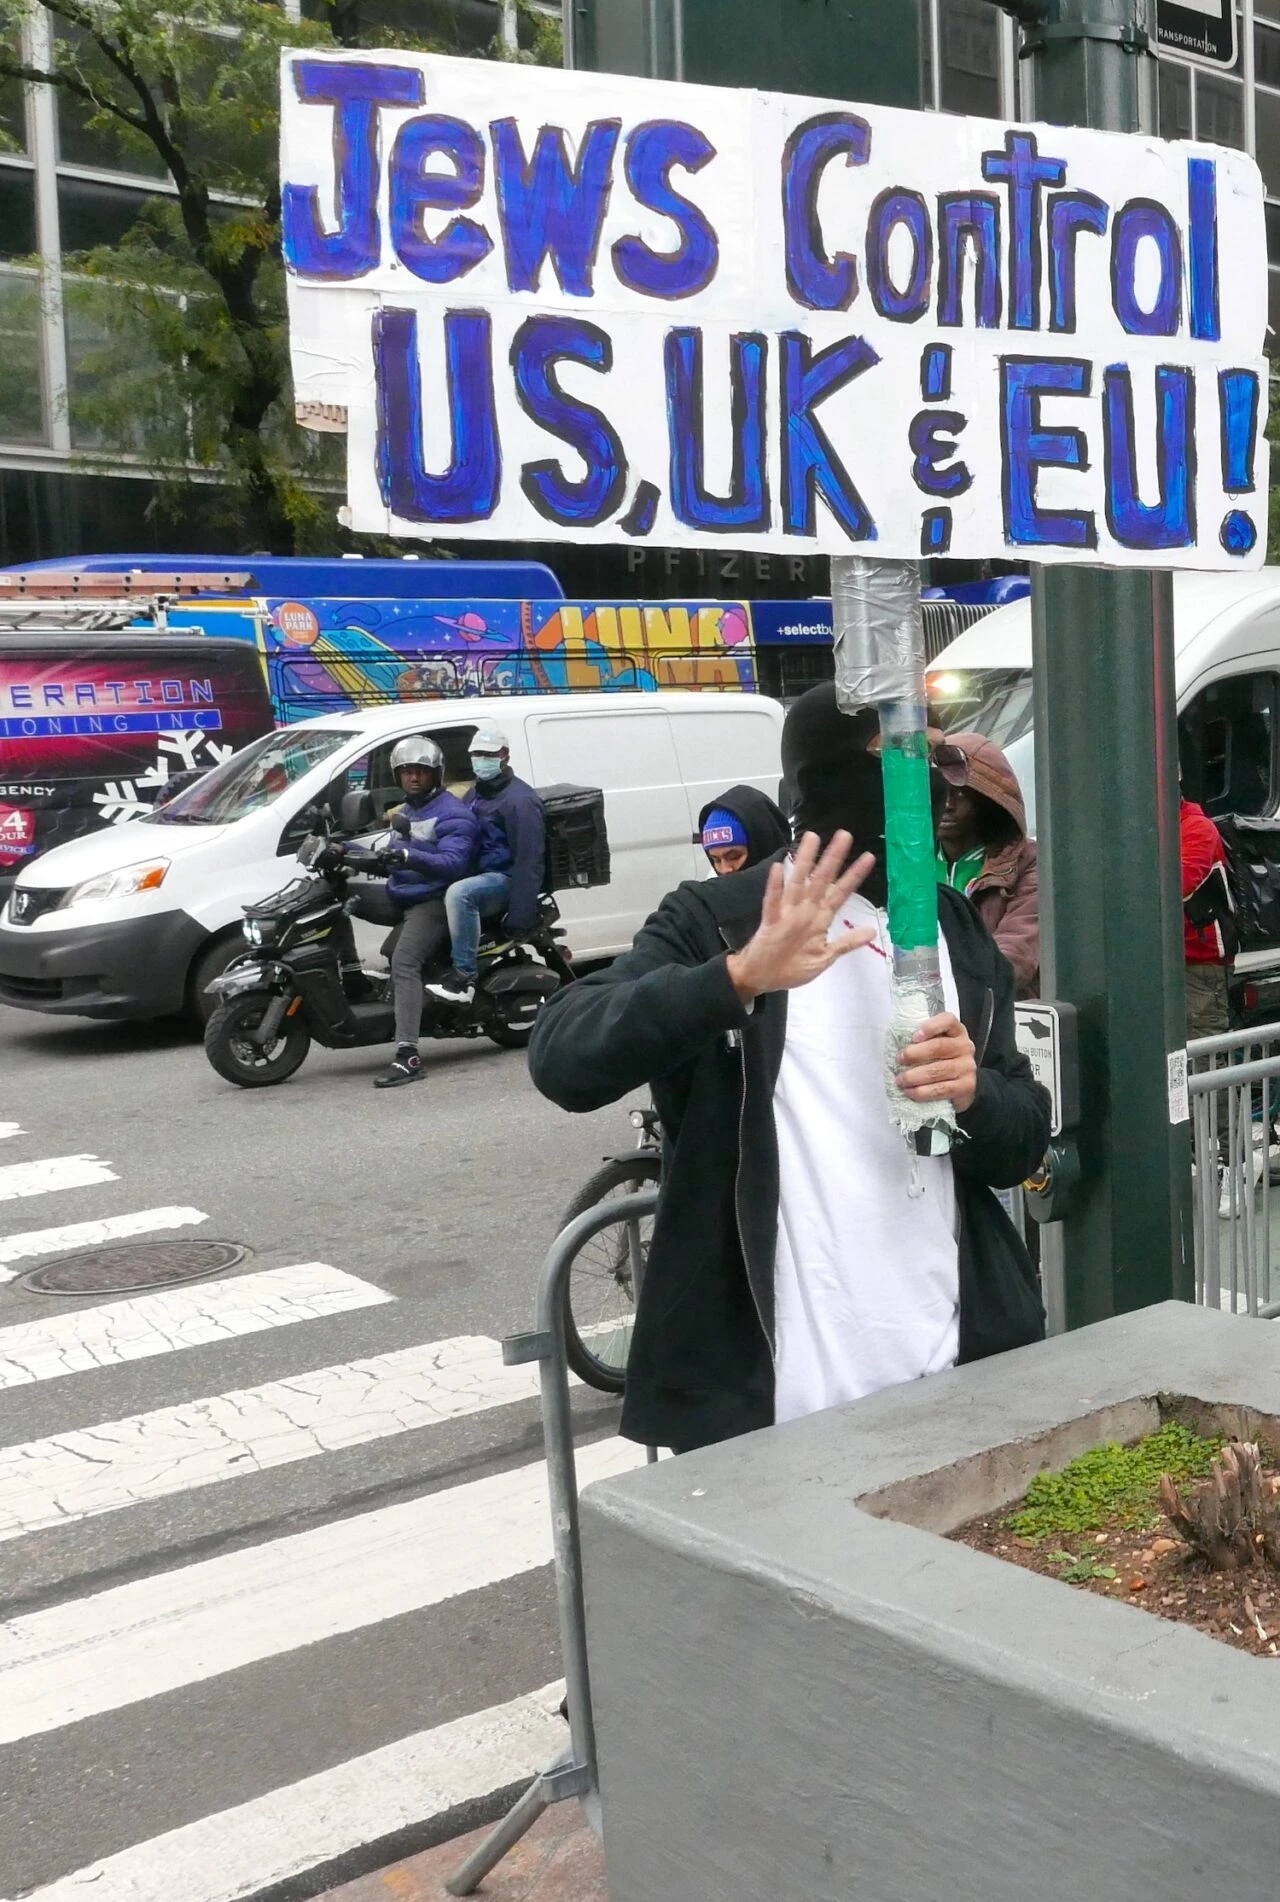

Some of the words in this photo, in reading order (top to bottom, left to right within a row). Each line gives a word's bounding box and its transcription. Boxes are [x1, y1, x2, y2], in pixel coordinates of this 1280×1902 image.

[283, 58, 719, 299] Jews
[782, 111, 1222, 342] Control
[999, 354, 1260, 556] EU!
[626, 546, 806, 582] PFIZER
[285, 620, 314, 631] PARK
[155, 710, 208, 730] INC
[1030, 1047, 1052, 1059] BUTTON
